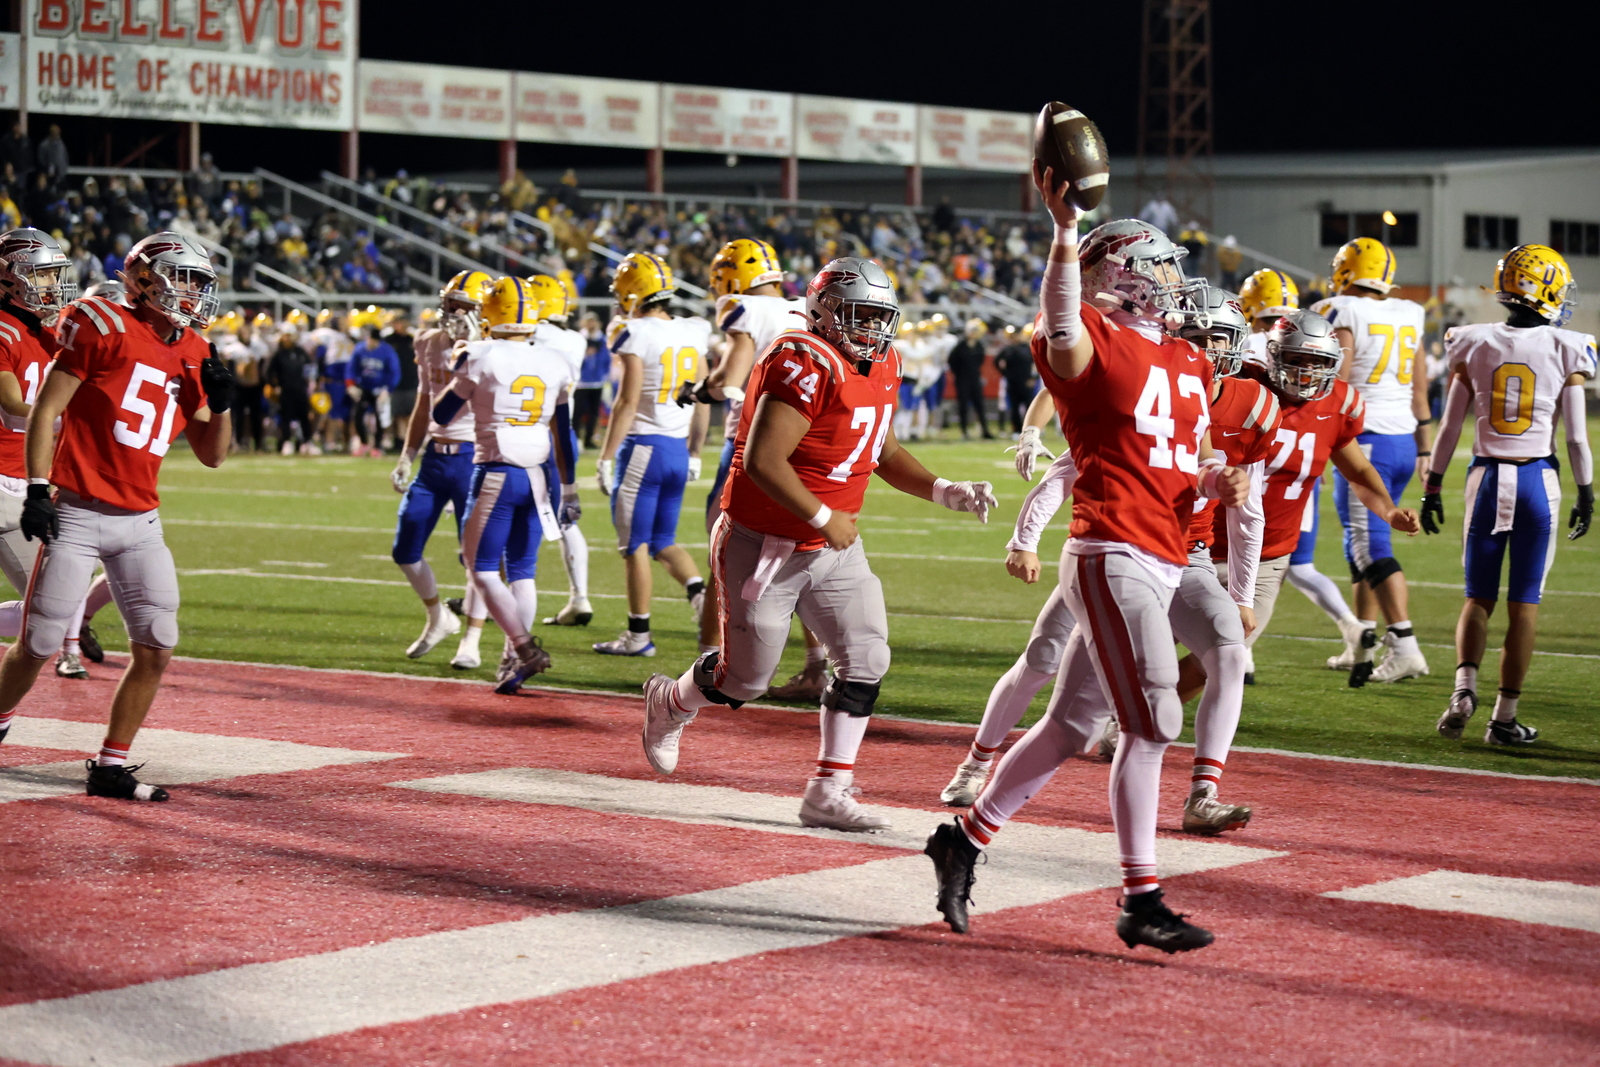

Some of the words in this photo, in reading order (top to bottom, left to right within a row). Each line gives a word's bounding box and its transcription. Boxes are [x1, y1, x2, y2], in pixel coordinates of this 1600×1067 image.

[36, 0, 343, 52] BELLEVUE
[38, 52, 115, 90] HOME
[137, 59, 169, 92] OF
[190, 62, 342, 104] CHAMPIONS
[56, 316, 81, 351] 51
[1366, 323, 1417, 385] 76
[505, 375, 546, 426] 3
[656, 346, 699, 404] 18
[782, 360, 819, 403] 74
[1489, 361, 1536, 435] 0
[113, 362, 181, 457] 51
[1134, 365, 1211, 475] 43
[827, 403, 893, 482] 74
[1264, 428, 1316, 500] 71
